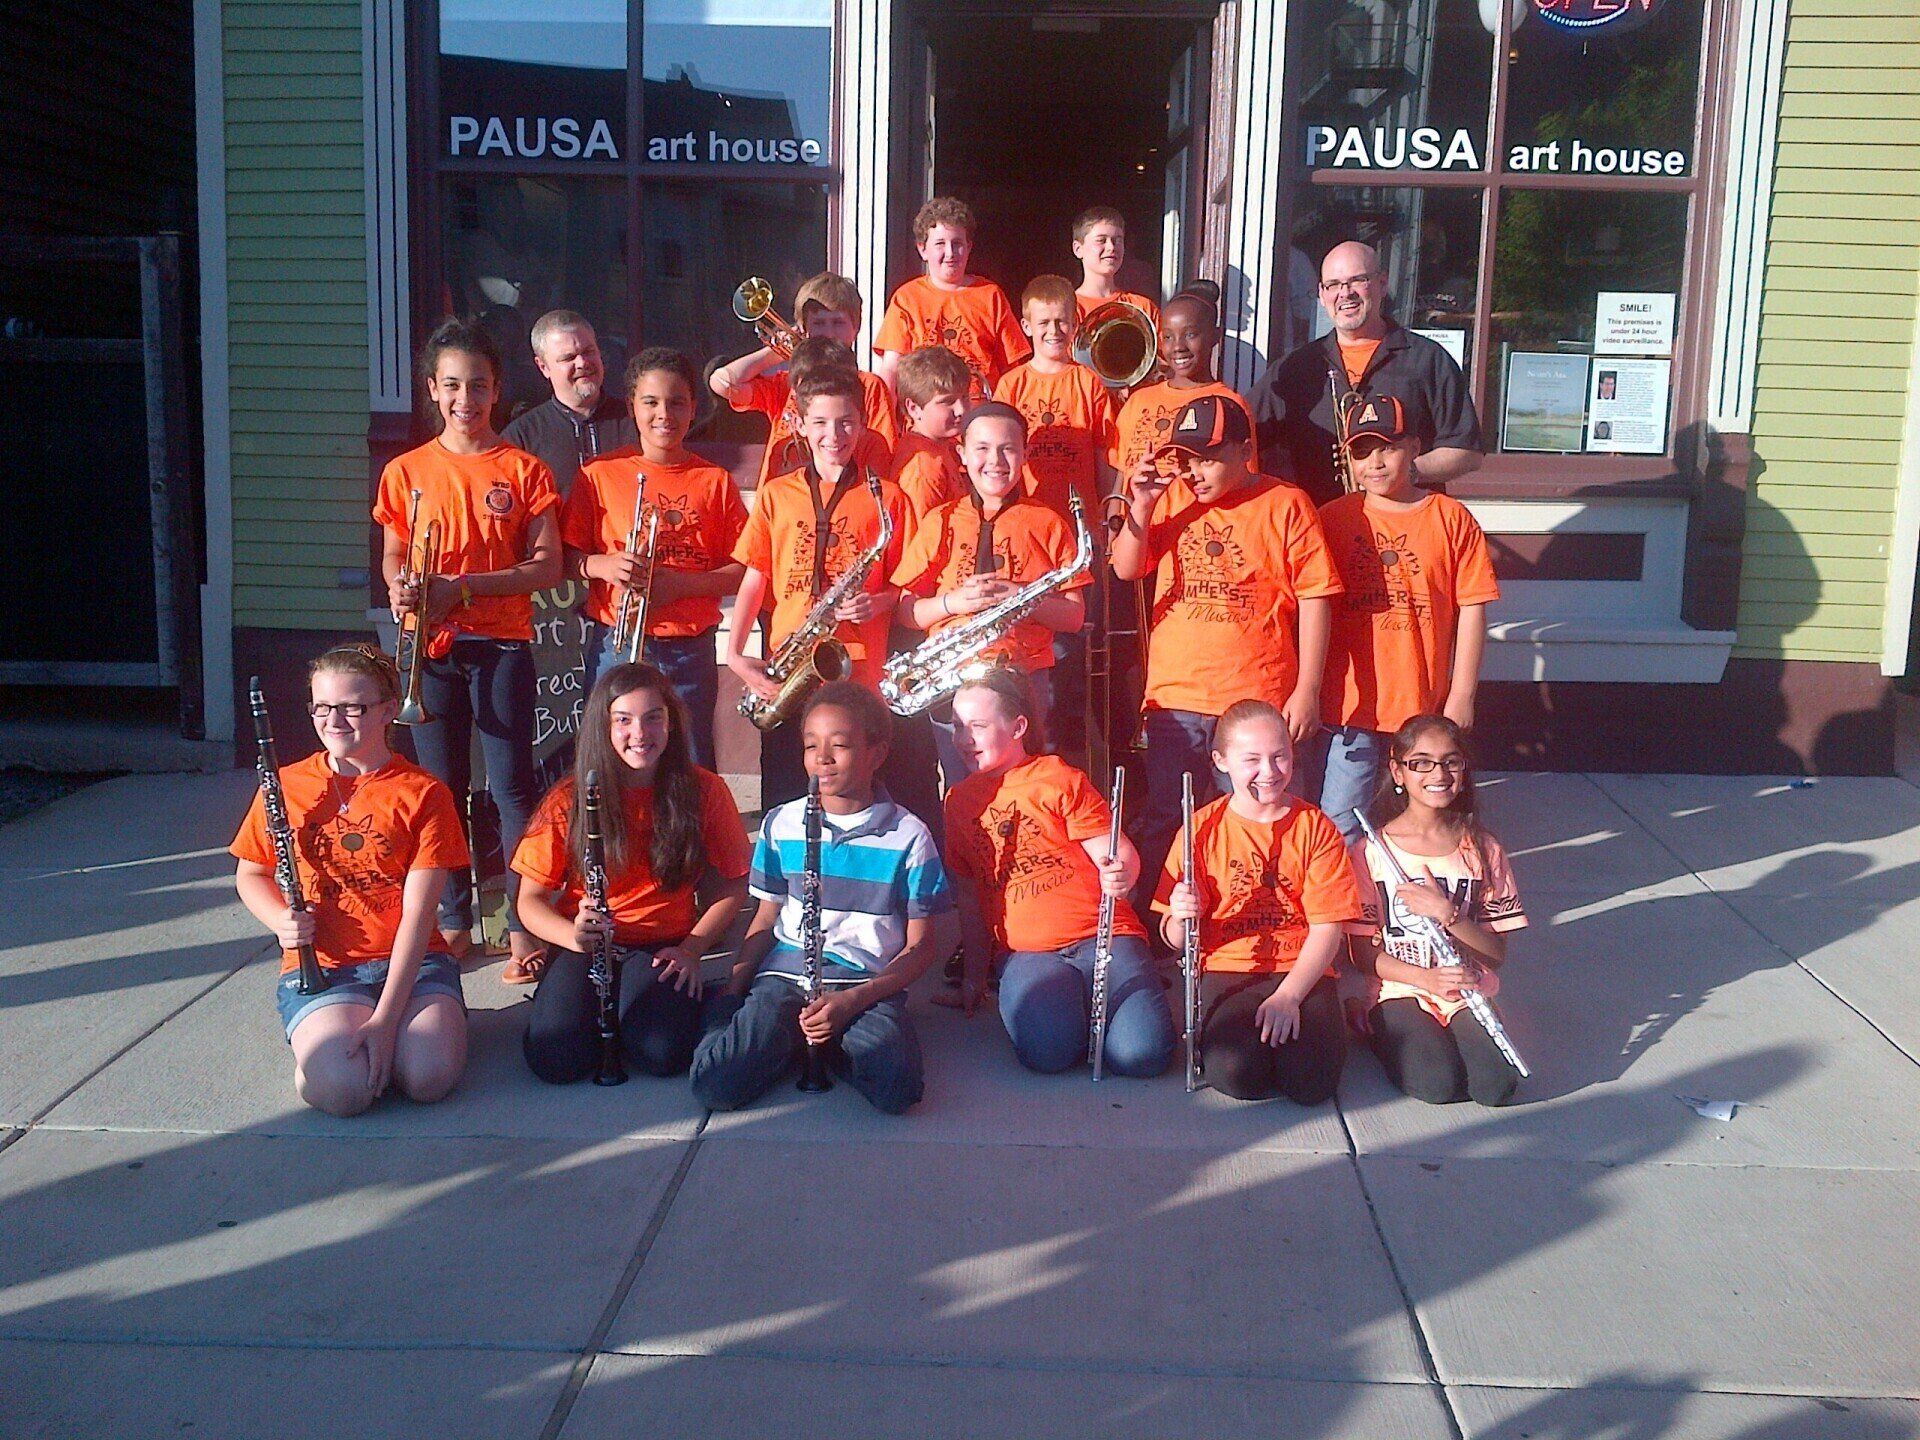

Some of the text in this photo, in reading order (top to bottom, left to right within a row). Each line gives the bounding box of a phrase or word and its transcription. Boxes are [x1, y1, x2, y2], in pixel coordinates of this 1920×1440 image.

[450, 116, 821, 163] PAUSA art house
[1306, 126, 1685, 175] PAUSA art house
[1620, 304, 1652, 312] SMILE!
[1178, 408, 1197, 430] A
[1359, 403, 1378, 424] A
[1184, 579, 1251, 609] MHERST
[533, 616, 565, 647] rt
[532, 699, 585, 746] Buf
